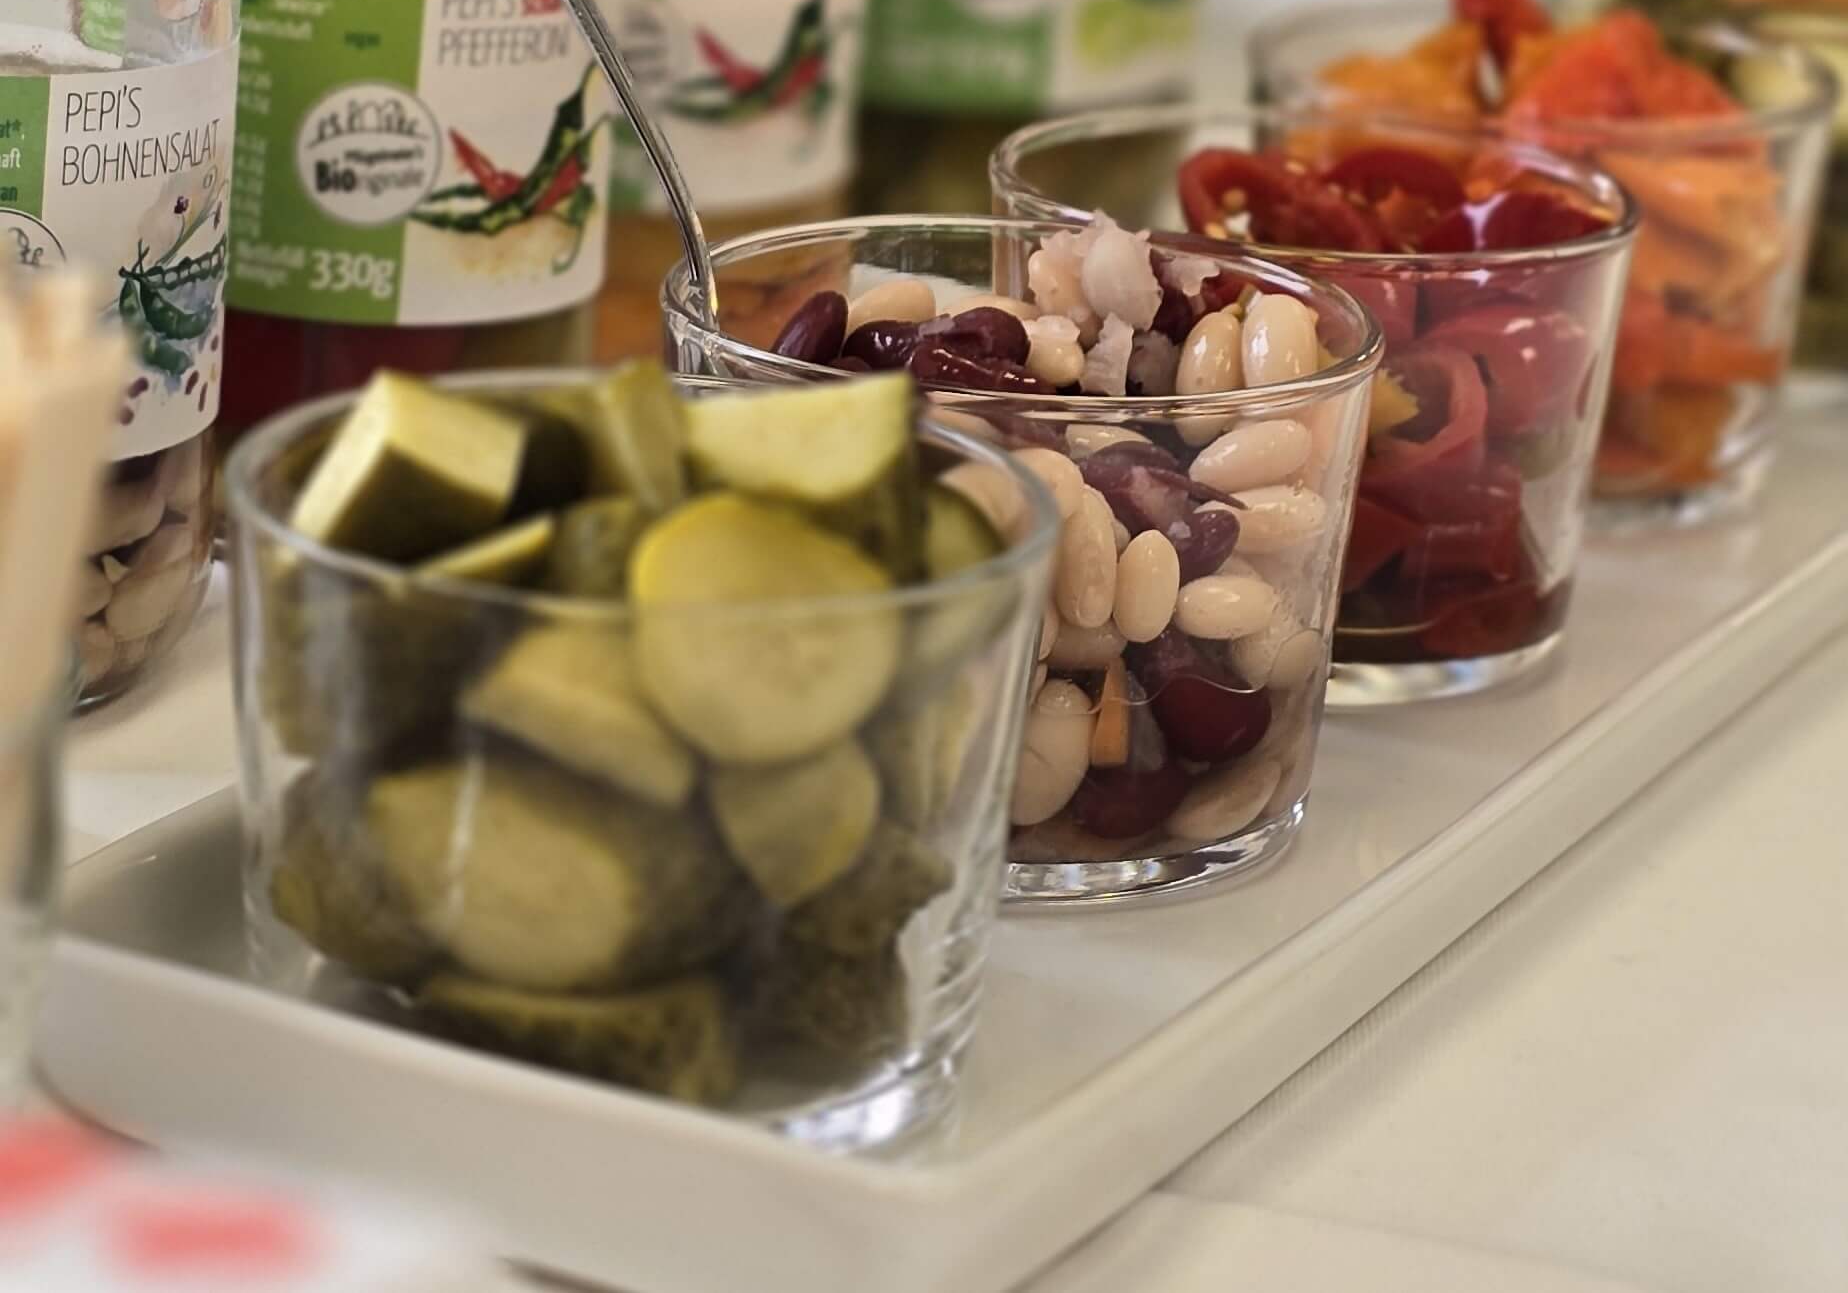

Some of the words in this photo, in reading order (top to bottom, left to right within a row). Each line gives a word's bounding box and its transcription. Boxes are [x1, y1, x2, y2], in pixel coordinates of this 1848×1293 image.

[64, 84, 143, 134] PEPI'S
[0, 147, 21, 169] aft
[61, 118, 221, 187] BOHNENSALAT
[308, 249, 395, 299] 330g
